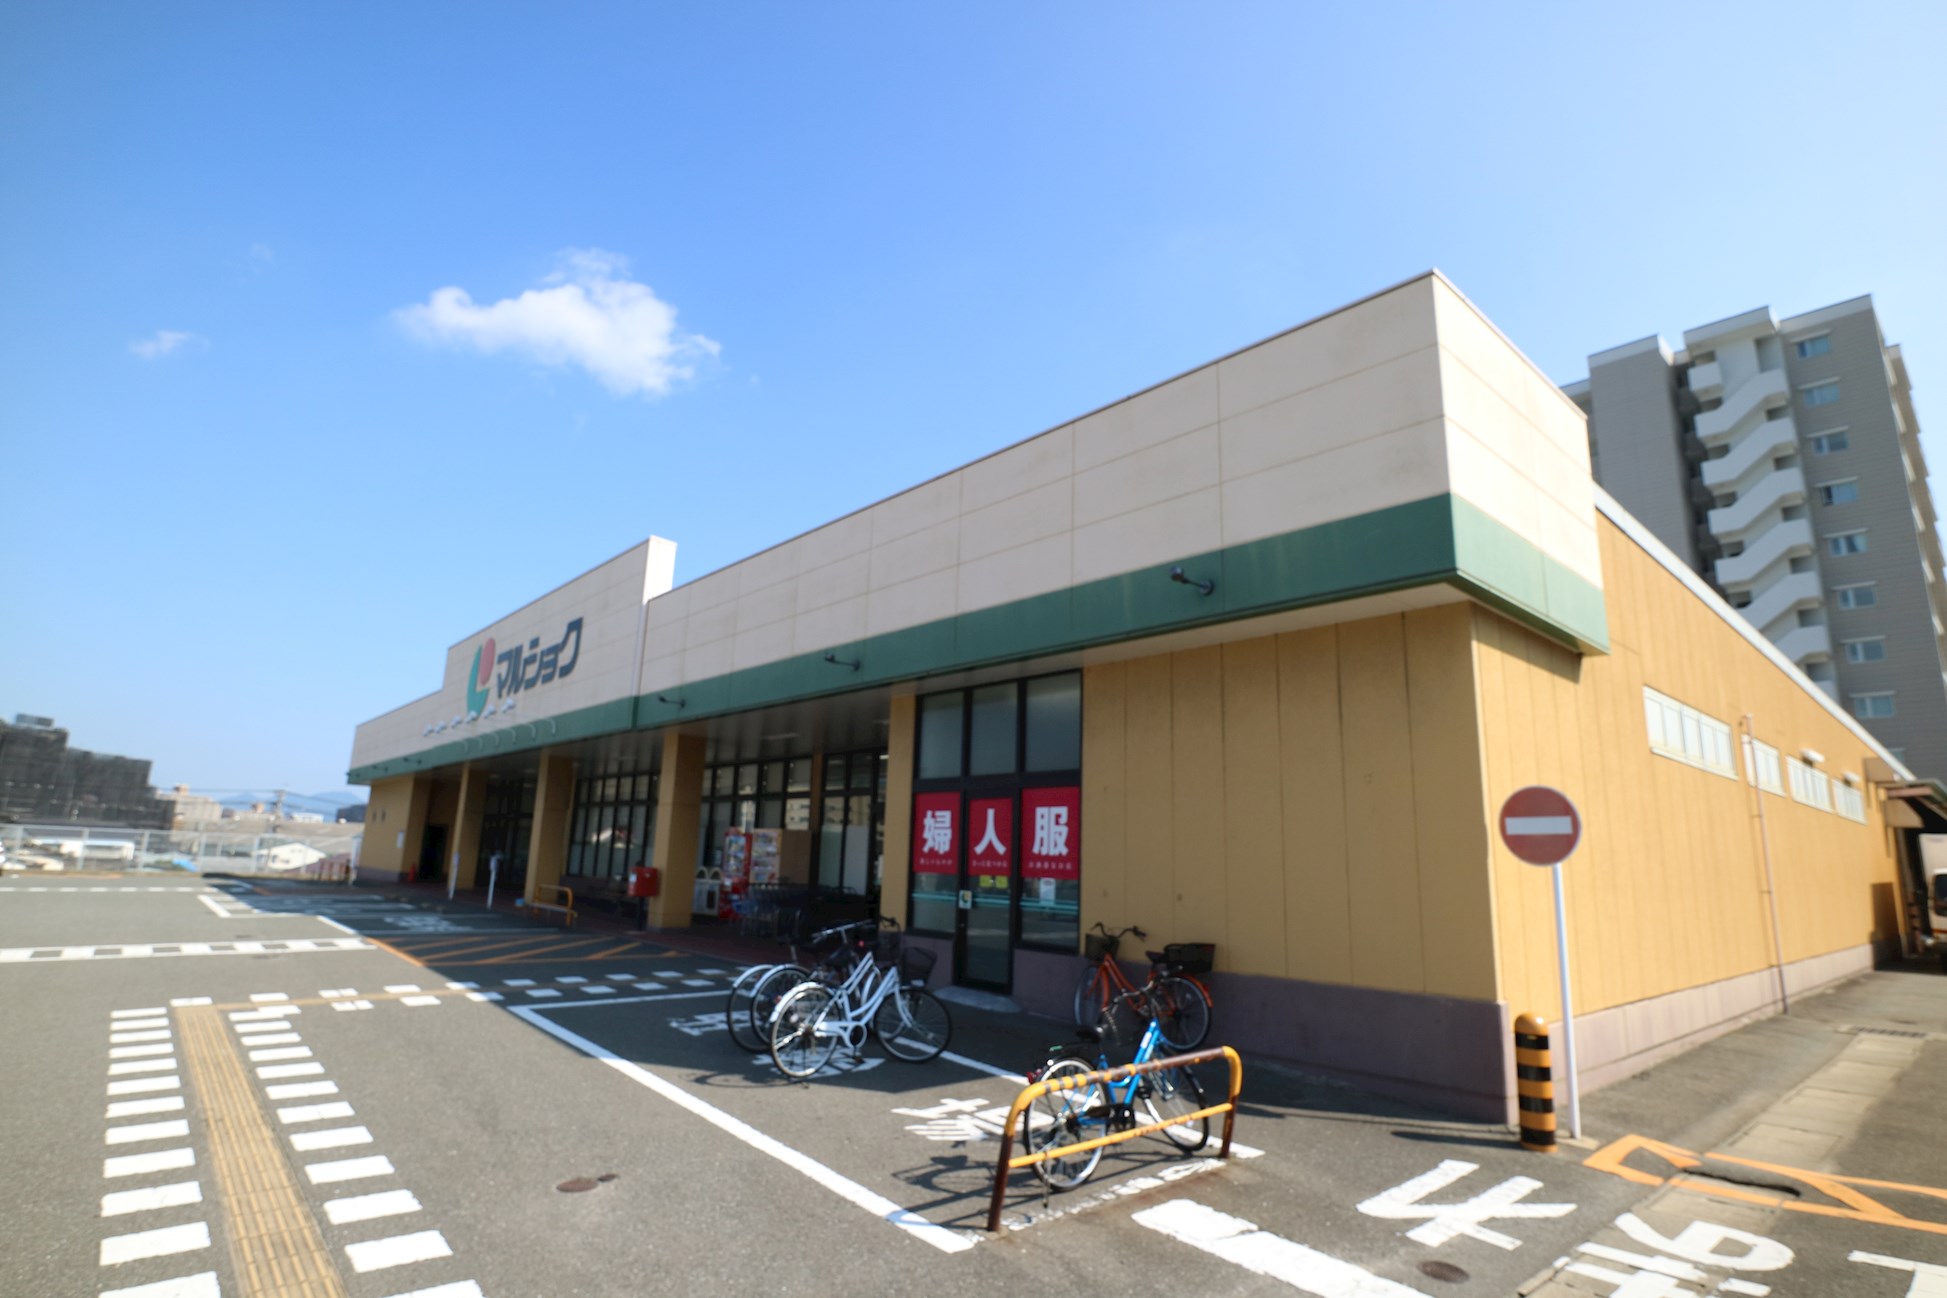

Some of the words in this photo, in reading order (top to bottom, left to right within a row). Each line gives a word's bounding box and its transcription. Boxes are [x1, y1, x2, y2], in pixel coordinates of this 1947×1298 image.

[497, 617, 583, 698] マルショク
[922, 806, 1070, 857] 婦人服
